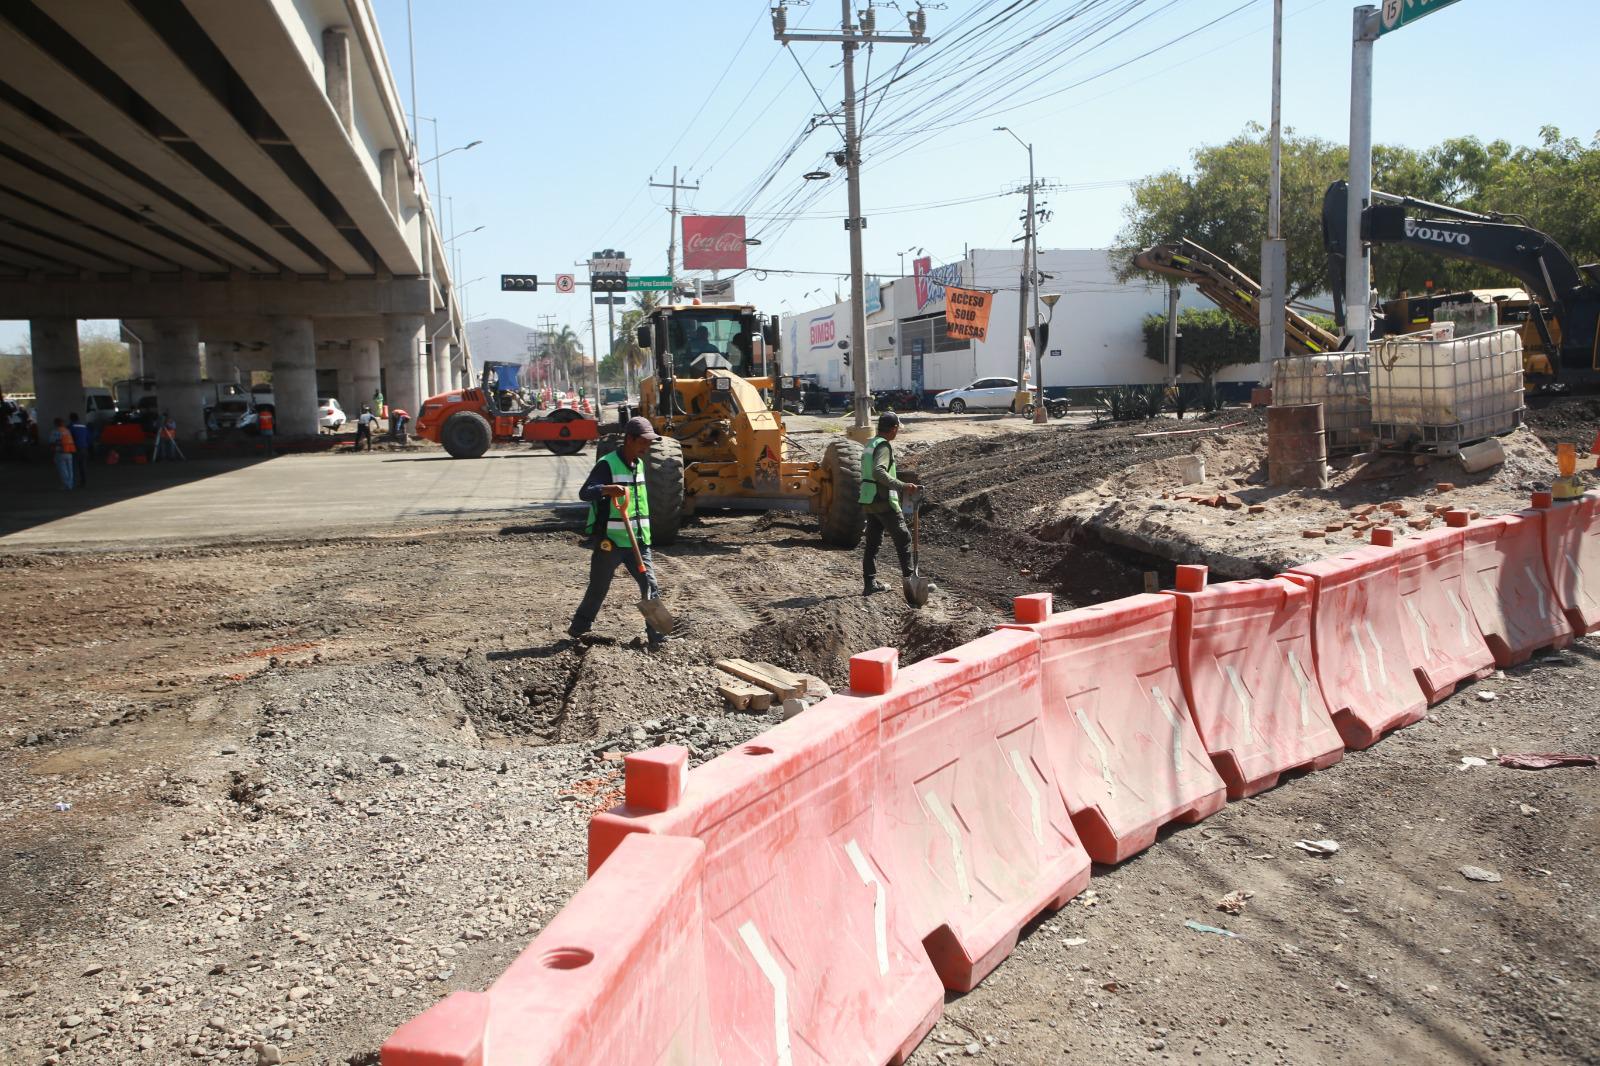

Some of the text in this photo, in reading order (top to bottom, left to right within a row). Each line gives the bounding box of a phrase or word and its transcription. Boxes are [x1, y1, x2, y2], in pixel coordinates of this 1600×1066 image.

[1386, 1, 1398, 21] 15
[1405, 225, 1471, 246] VOLVO
[951, 292, 984, 308] ACCESO
[954, 308, 976, 321] SOLO
[809, 319, 835, 346] BIMBO
[947, 322, 985, 338] MPRESAS
